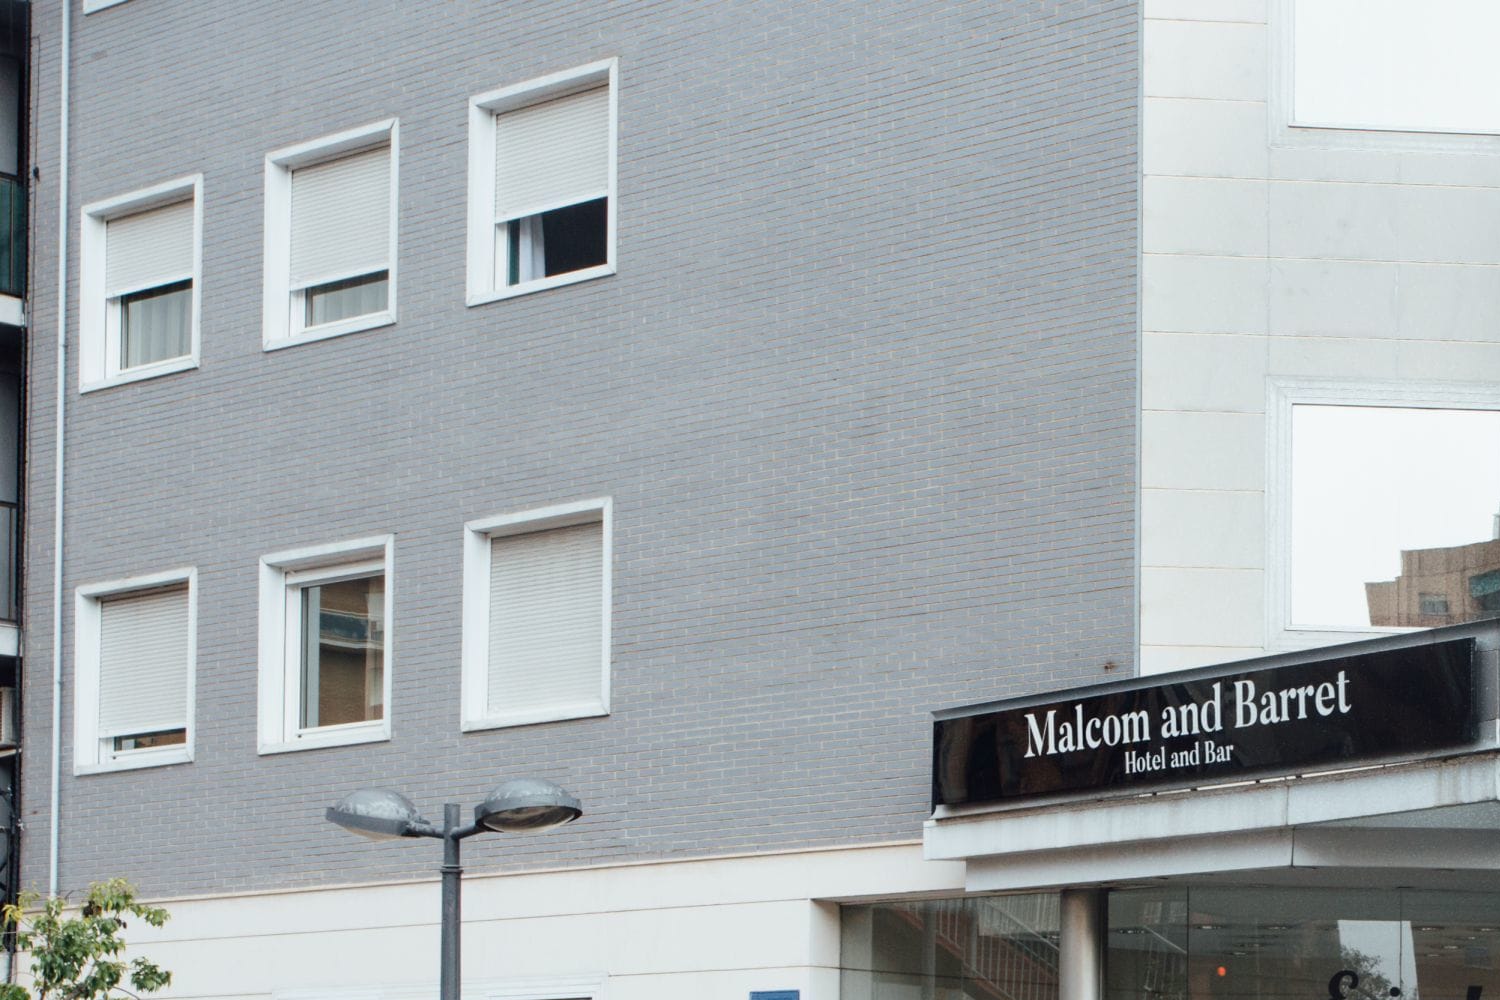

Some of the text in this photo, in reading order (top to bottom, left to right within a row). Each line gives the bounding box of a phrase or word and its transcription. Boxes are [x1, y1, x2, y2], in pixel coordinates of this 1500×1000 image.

[1023, 670, 1353, 758] Malcom and Barret
[1124, 741, 1235, 774] Hotel and Bar
